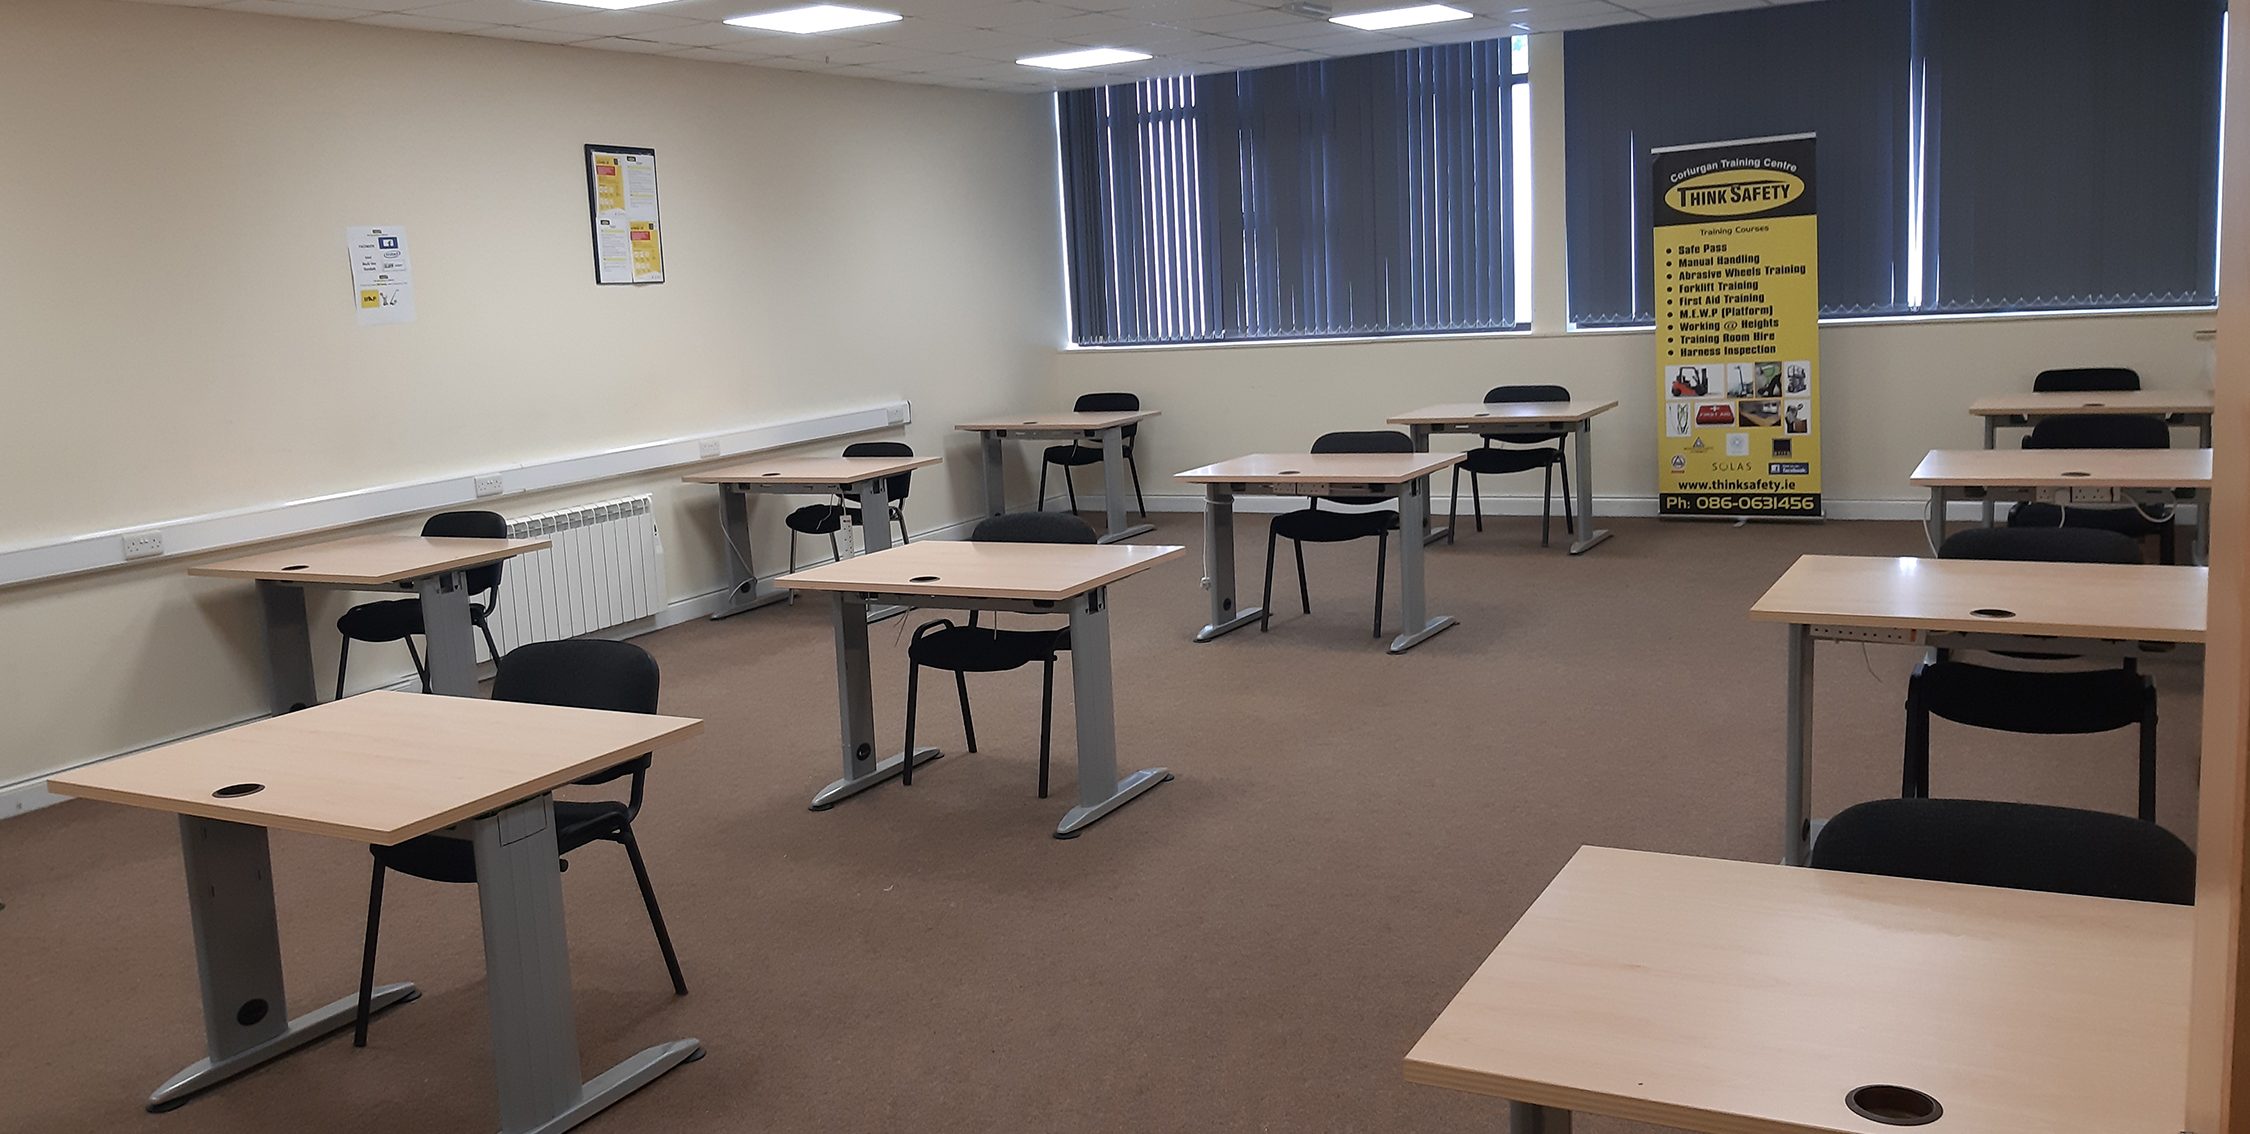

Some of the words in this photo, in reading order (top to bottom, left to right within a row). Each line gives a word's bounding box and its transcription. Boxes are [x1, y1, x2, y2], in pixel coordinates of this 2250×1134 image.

[1721, 158, 1761, 168] Training
[1763, 158, 1797, 173] Centre
[1700, 226, 1733, 236] Training
[1735, 225, 1769, 234] Courses
[1678, 245, 1700, 255] Safe
[1703, 244, 1727, 253] Pass
[1678, 257, 1713, 268] Manual
[1716, 254, 1760, 265] Handling
[1679, 269, 1722, 281] Abrasive
[1725, 267, 1761, 278] Wheels
[1764, 265, 1806, 275] Training
[1679, 283, 1714, 293] Forklift
[1717, 280, 1759, 291] Training
[1679, 296, 1701, 306] First
[1705, 295, 1720, 305] Aid
[1724, 293, 1765, 304] Training
[1680, 322, 1720, 332] Working
[1723, 321, 1738, 331] @
[1741, 318, 1779, 330] Heights
[1680, 334, 1720, 344] Training
[1723, 333, 1750, 343] Room
[1753, 332, 1775, 341] Hire
[1680, 347, 1721, 357] Harness
[1724, 345, 1776, 356] Inspection
[1678, 479, 1796, 492] www.thinksafety.ie
[1666, 497, 1691, 509] Ph:
[1696, 497, 1815, 510] 086-0631456
